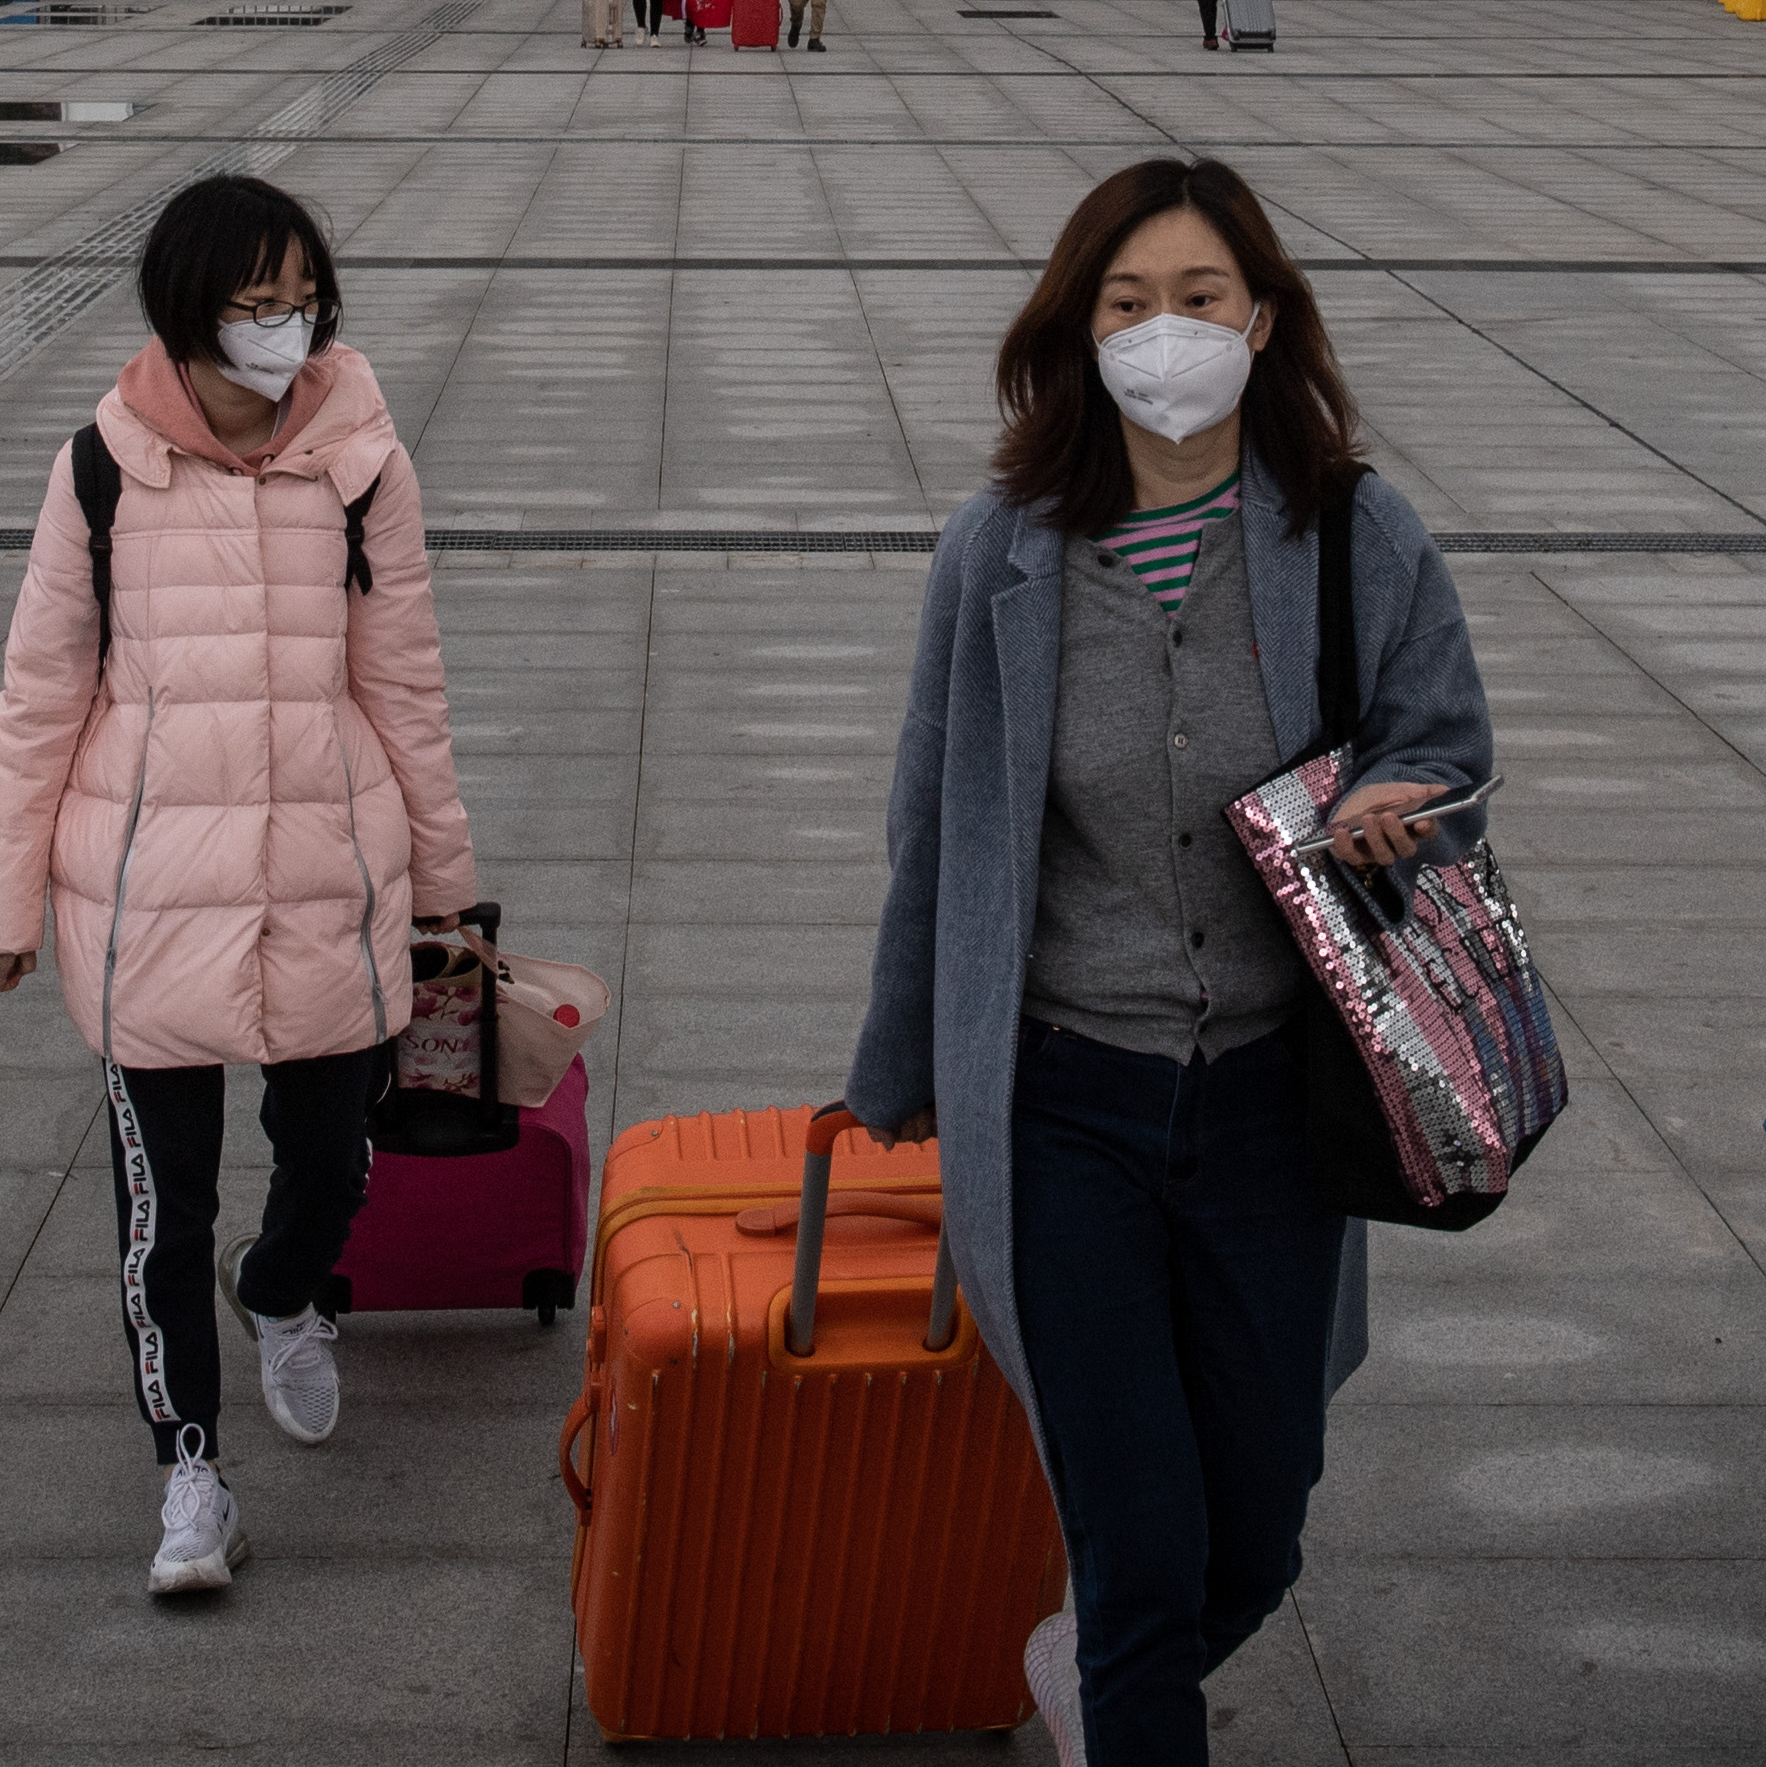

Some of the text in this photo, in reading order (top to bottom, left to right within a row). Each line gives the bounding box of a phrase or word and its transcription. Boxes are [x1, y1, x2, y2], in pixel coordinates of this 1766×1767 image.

[123, 1108, 142, 1148] FILA
[131, 1153, 149, 1195] FILA
[134, 1200, 151, 1242] FILA
[127, 1247, 145, 1287] FILA
[128, 1293, 146, 1330] FILA
[144, 1332, 160, 1375] FILA
[147, 1379, 171, 1421] FILA
